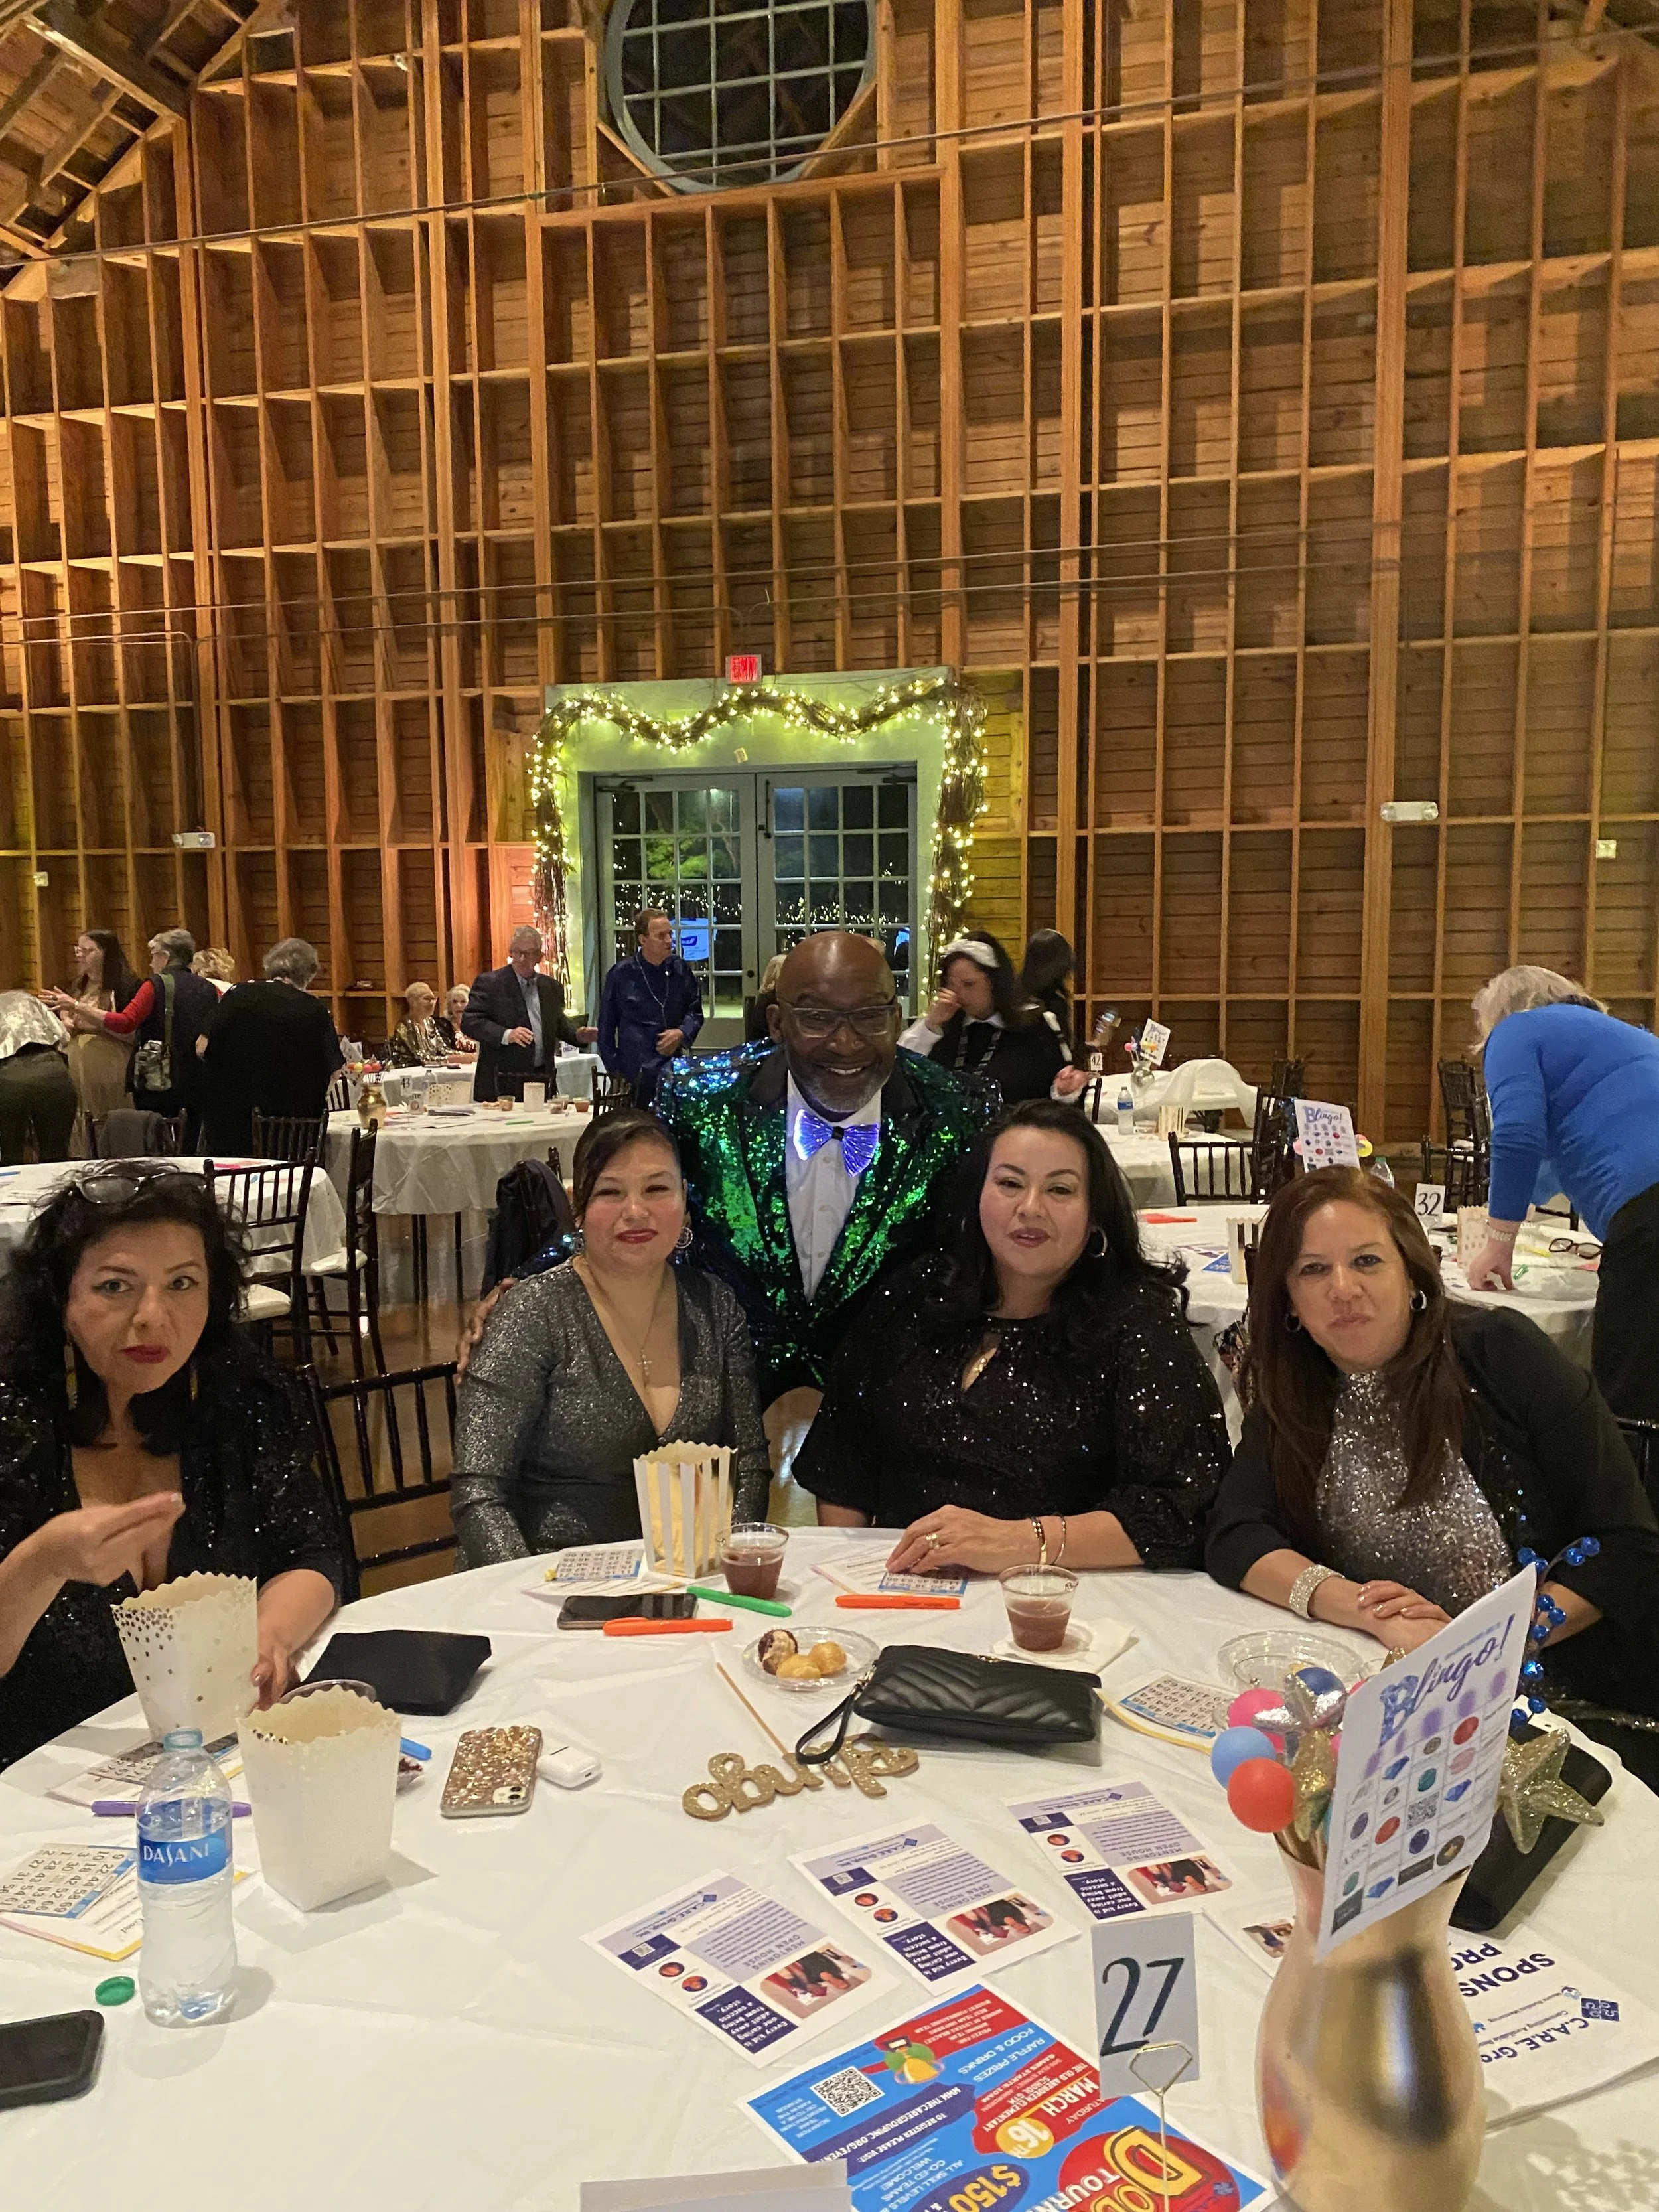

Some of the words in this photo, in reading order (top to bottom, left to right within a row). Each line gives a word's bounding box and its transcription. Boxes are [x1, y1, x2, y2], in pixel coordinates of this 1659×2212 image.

[732, 658, 757, 681] EXIT
[400, 1077, 411, 1089] 43
[1417, 1193, 1441, 1217] 32
[1380, 1613, 1515, 1747] Blingo!
[143, 1843, 209, 1867] DASANI
[716, 2005, 748, 2022] success
[743, 2006, 765, 2018] from
[1100, 1957, 1184, 2056] 27
[719, 2016, 745, 2029] being
[749, 2011, 772, 2024] adult
[763, 2020, 788, 2035] Every
[728, 2022, 751, 2035] away
[735, 2025, 764, 2040] caring
[750, 2033, 767, 2043] kid
[1002, 2028, 1035, 2047] FOOD
[1514, 2018, 1589, 2050] C.A.R.E.
[1007, 2037, 1046, 2061] RAFFLE
[956, 2049, 997, 2075] DRINKS
[972, 2058, 1010, 2082] PRIZES
[1029, 2053, 1056, 2071] GAMES
[1071, 2061, 1088, 2073] THE
[1021, 2075, 1050, 2095] SCHOOL
[1058, 2069, 1076, 2081] OLD
[1024, 2077, 1062, 2102] ABERDEEN
[1039, 2077, 1100, 2117] MARCH
[933, 2112, 947, 2120] TO
[981, 2099, 1029, 2132] ELEMENTARY
[1062, 2097, 1105, 2124] ATURDAY
[901, 2117, 938, 2138] REGISTER
[875, 2134, 904, 2152] PLEASE
[879, 2156, 933, 2191] WELCOME!
[912, 2159, 947, 2181] CO-ED
[944, 2159, 964, 2172] ALL
[920, 2170, 948, 2187] SKILL
[1024, 2167, 1121, 2211] TOURN
[880, 2178, 916, 2201] TEAMS
[887, 2185, 924, 2209] LEVELS
